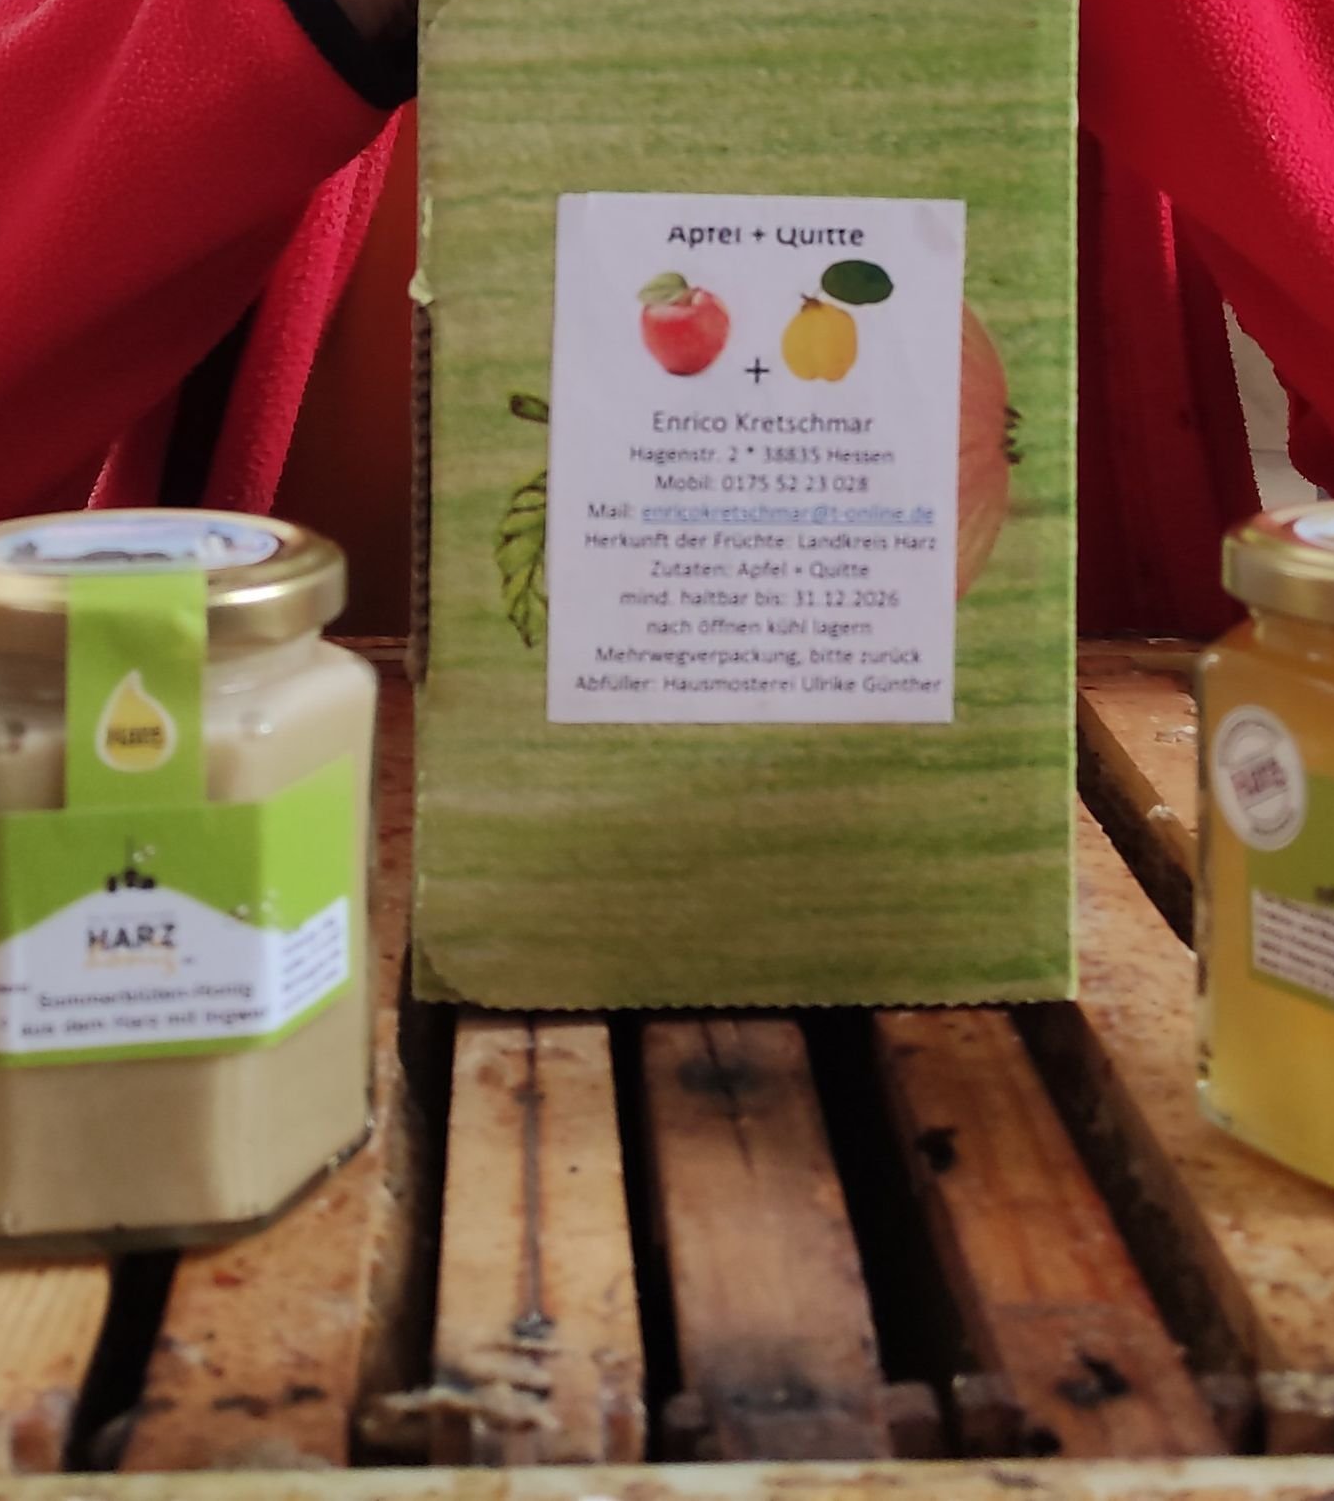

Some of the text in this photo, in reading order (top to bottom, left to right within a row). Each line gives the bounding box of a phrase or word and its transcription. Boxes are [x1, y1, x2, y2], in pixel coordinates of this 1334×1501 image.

[667, 226, 865, 250] Apfel + Quitte
[652, 410, 874, 435] Enrico Kretschmar
[629, 446, 718, 467] Hagenstr.
[727, 446, 738, 463] 2
[827, 448, 895, 465] Hessen
[655, 474, 869, 493] Mobil: 0175 52 23 028
[587, 502, 632, 520] Mail:
[585, 531, 669, 550] Herkunft
[675, 532, 707, 550] der
[798, 533, 888, 551] Landkreis
[650, 560, 729, 579] Zutaten:
[737, 560, 787, 580] Apfel
[809, 561, 870, 579] Quitte
[680, 589, 748, 608] haltbar
[646, 619, 692, 636] nach
[767, 618, 807, 637] kühl
[813, 619, 873, 639] lagern
[595, 646, 921, 667] Mehrwegverpackung, bitte zurück
[802, 676, 856, 694] Ulrike
[87, 922, 177, 951] HARZ
